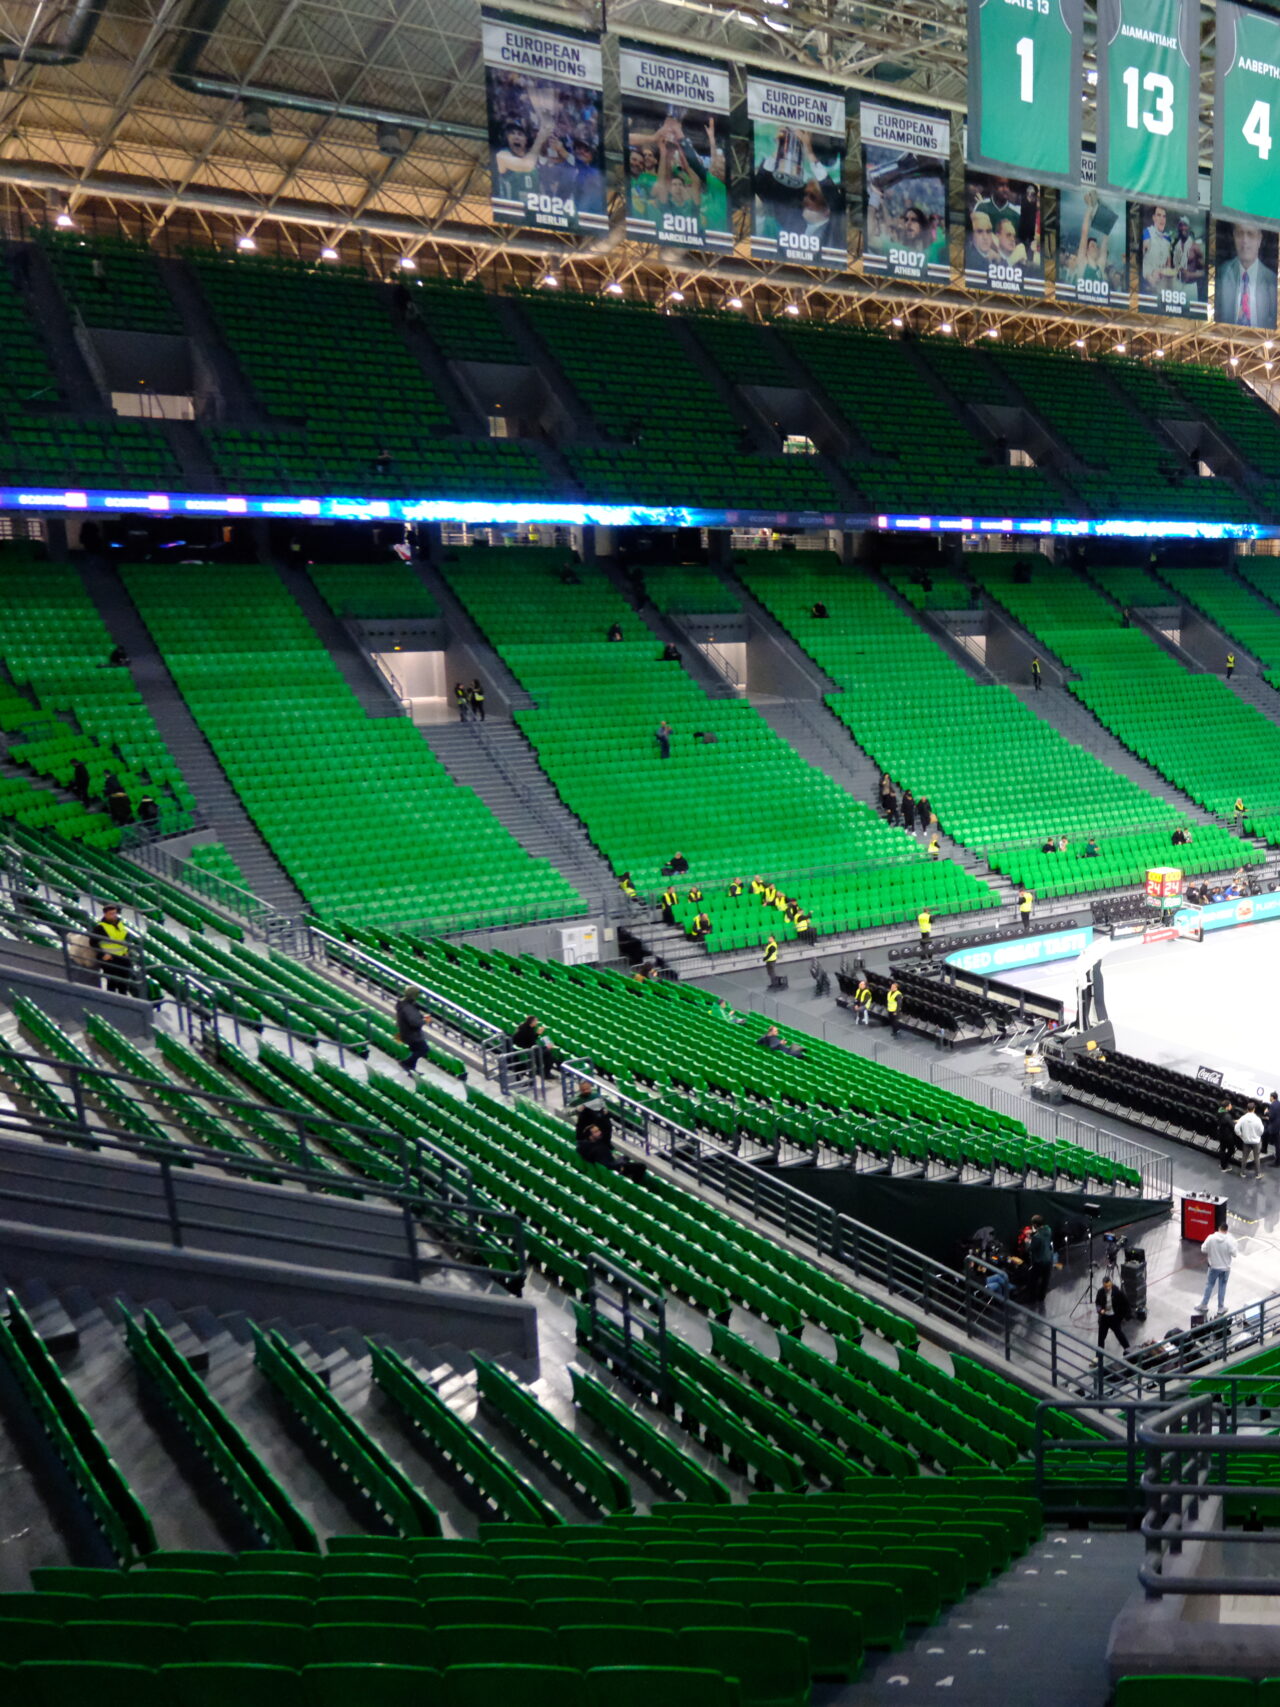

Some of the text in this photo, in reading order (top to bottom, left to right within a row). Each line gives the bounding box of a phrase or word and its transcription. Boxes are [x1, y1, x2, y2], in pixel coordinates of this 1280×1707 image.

[505, 32, 580, 61] EUROPEAN
[1121, 24, 1177, 50] ΔΙΑΜΑΝΤΙΔΗΣ
[501, 47, 586, 78] CHAMPIONS
[1016, 37, 1034, 104] 1
[640, 61, 709, 88] EUROPEAN
[636, 77, 714, 103] CHAMPIONS
[766, 88, 828, 113] EUROPEAN
[1123, 66, 1174, 136] 13
[762, 102, 832, 127] CHAMPIONS
[877, 114, 933, 136] EUROPEAN
[873, 127, 938, 149] CHAMPIONS
[1242, 100, 1272, 160] 4
[527, 193, 575, 216] 2024
[536, 213, 568, 227] BERLIN
[663, 213, 698, 234] 2011
[779, 231, 820, 251] 2009
[786, 249, 814, 261] BERLIN
[889, 248, 926, 268] 2007
[988, 264, 1023, 282] 2002
[1077, 278, 1108, 295] 2000
[1161, 289, 1187, 305] 1996
[1147, 880, 1160, 895] 24
[1164, 881, 1180, 896] 24
